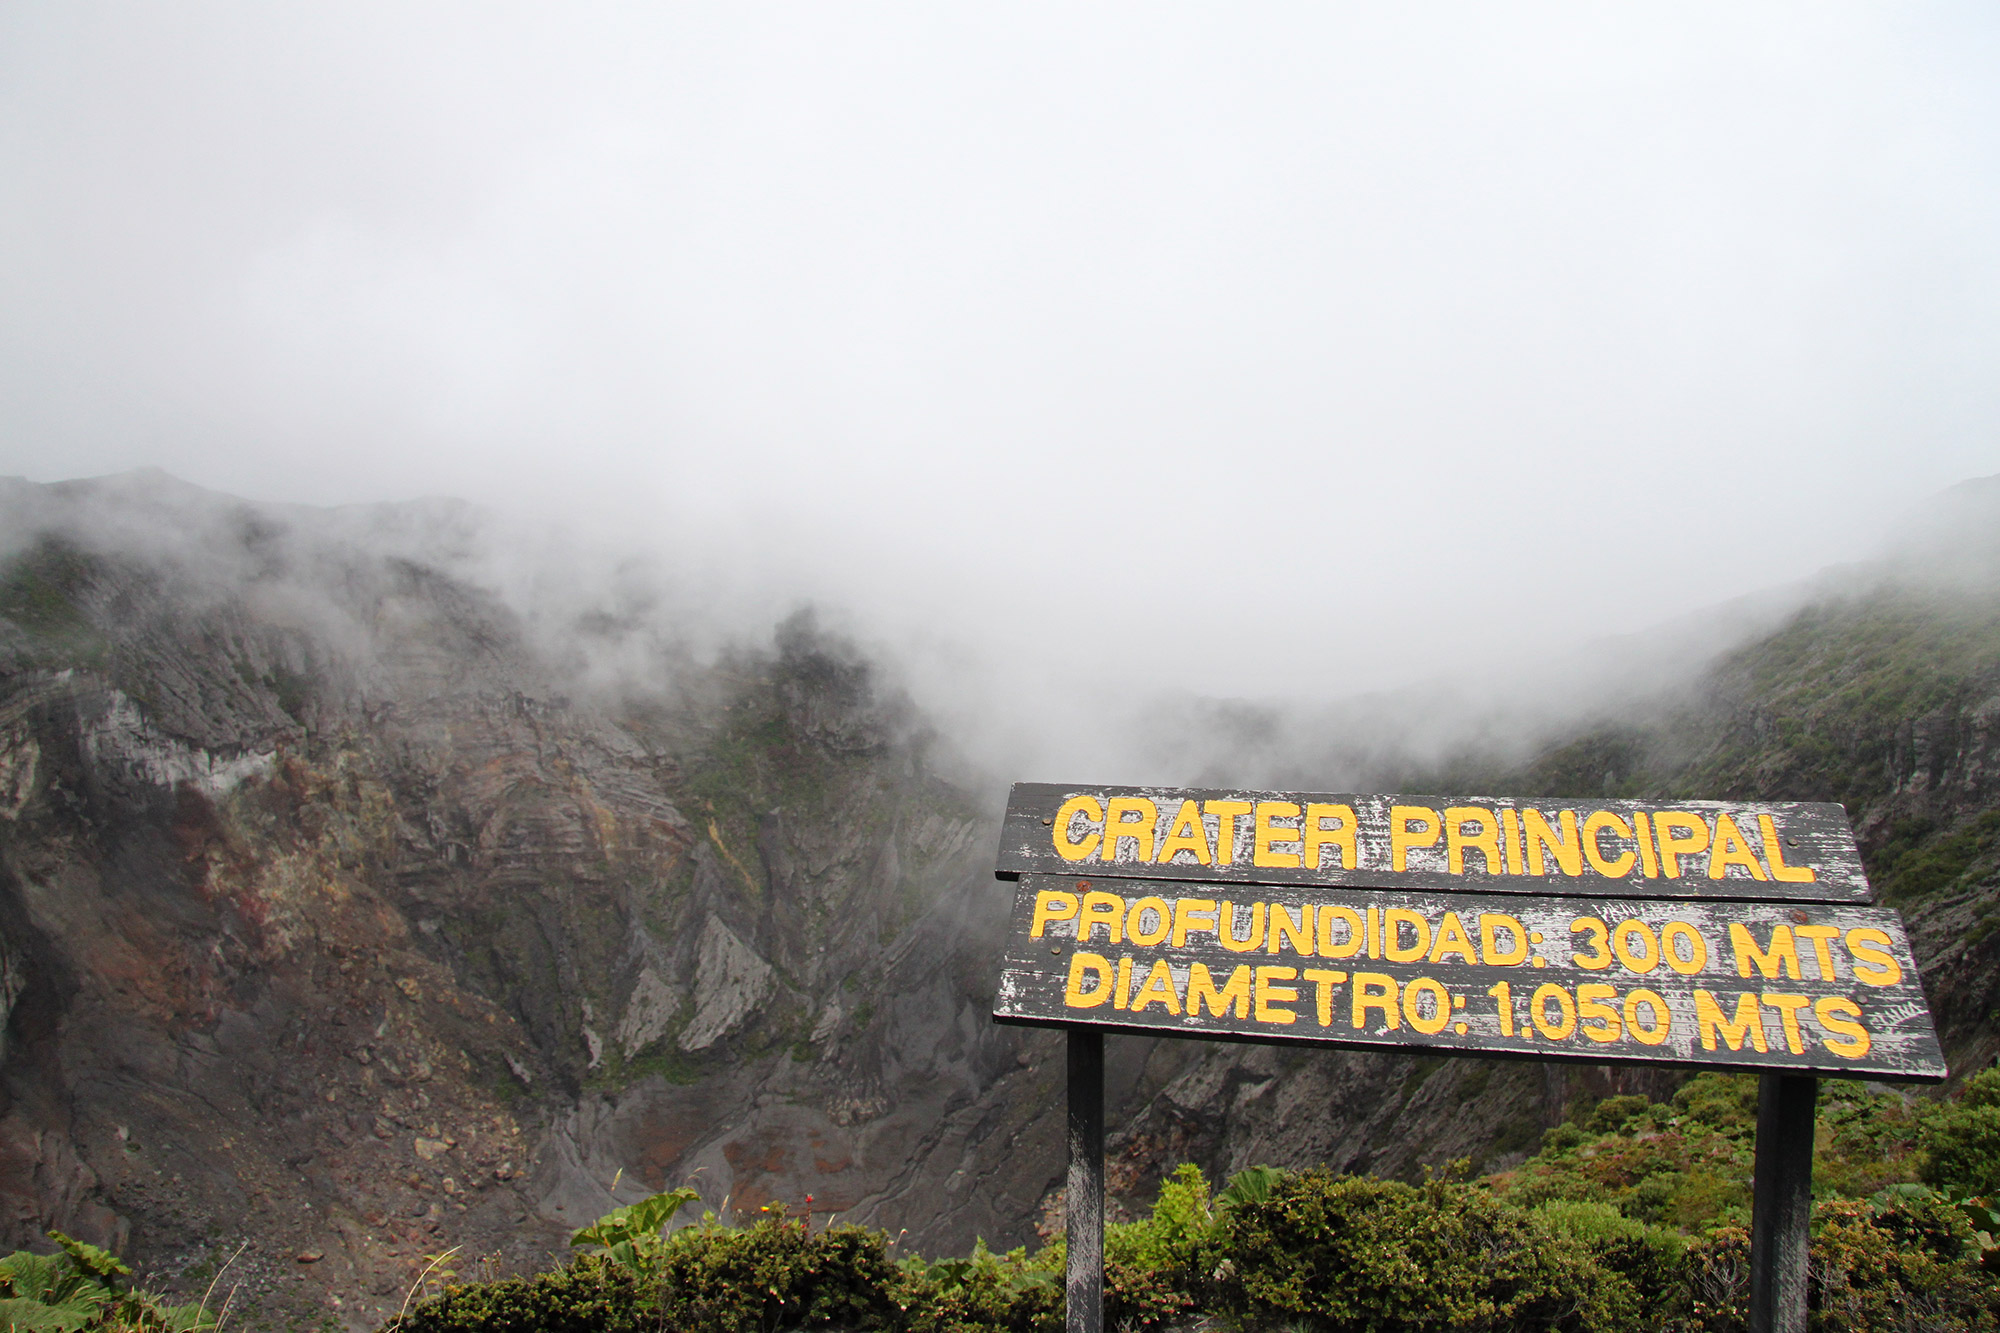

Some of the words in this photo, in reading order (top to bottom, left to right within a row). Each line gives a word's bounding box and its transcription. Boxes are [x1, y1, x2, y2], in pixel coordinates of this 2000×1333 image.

[1053, 796, 1359, 870] CRATER
[1391, 805, 1815, 884] PRINCIPAL
[1030, 890, 1546, 969] PROFUNDIDAD:
[1570, 917, 1708, 976] 300
[1729, 922, 1903, 986] MTS
[1065, 953, 1468, 1036] DIAMETRO:
[1488, 981, 1672, 1046] 1.050
[1694, 989, 1871, 1059] MTS
